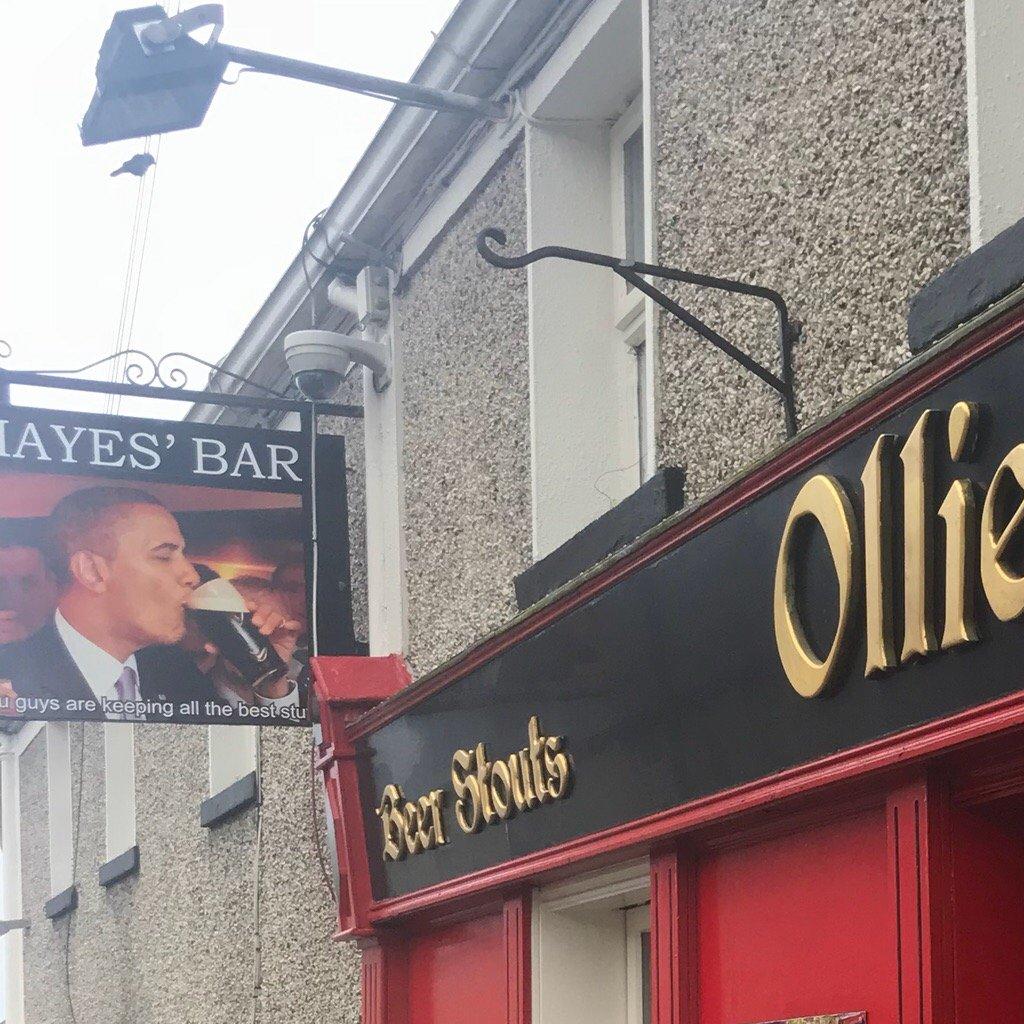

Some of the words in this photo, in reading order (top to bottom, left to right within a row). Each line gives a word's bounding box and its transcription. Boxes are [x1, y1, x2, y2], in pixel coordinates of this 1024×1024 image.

[191, 436, 303, 482] BAR
[15, 696, 61, 713] guys
[66, 698, 96, 711] are
[102, 698, 174, 717] keeping
[179, 700, 200, 715] all
[204, 702, 233, 716] the
[238, 702, 276, 718] best
[452, 715, 569, 834] Stouts
